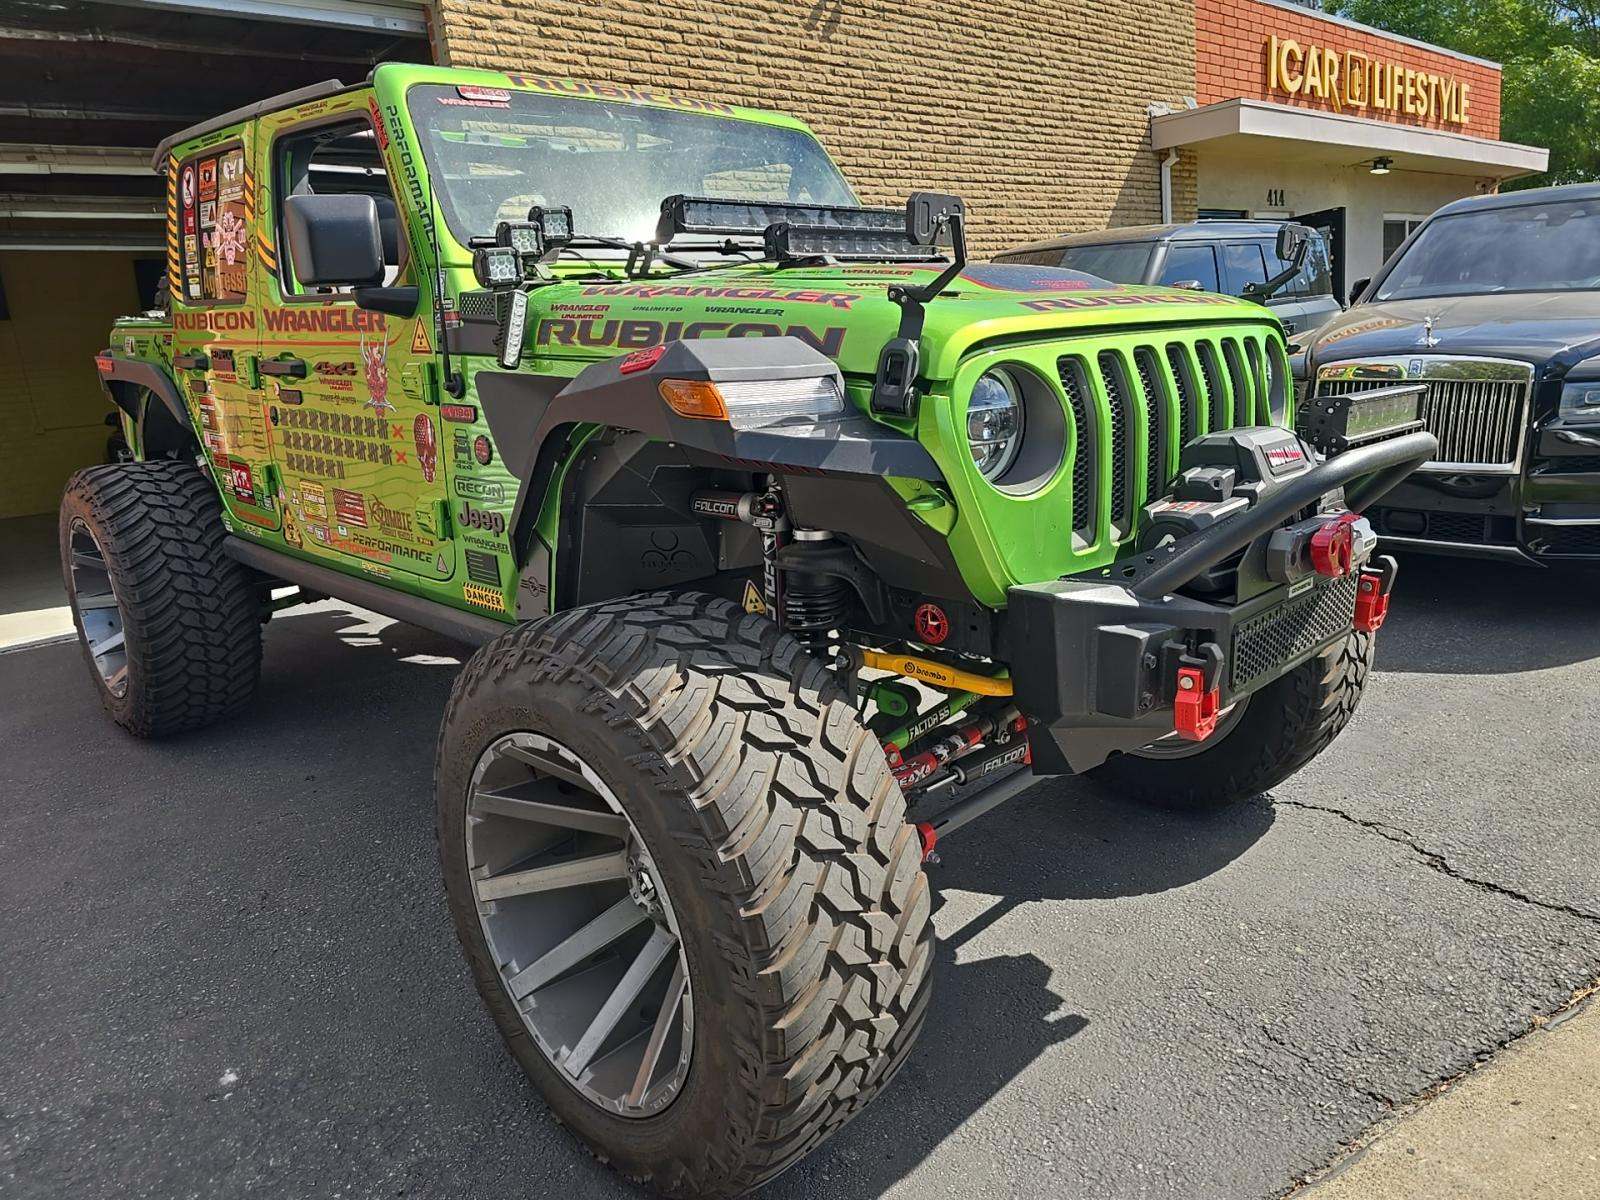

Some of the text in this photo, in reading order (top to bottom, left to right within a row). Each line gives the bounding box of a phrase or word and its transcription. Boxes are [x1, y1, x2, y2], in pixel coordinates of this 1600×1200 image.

[1267, 34, 1470, 125] ICAR LIFESTYLE
[386, 105, 442, 255] PERFORMANCE
[1266, 189, 1286, 207] 414
[551, 303, 611, 313] WRANGLER
[705, 306, 785, 317] WRANGLER
[581, 284, 857, 309] WRANGLER
[174, 308, 387, 332] RUBICON WRANGLER
[458, 499, 505, 538] Jeep
[694, 500, 735, 514] FALCON
[352, 532, 433, 564] PERFORMANCE
[466, 588, 502, 608] DANGER
[909, 705, 951, 740] FACTOR 55
[984, 745, 1027, 774] FALCON
